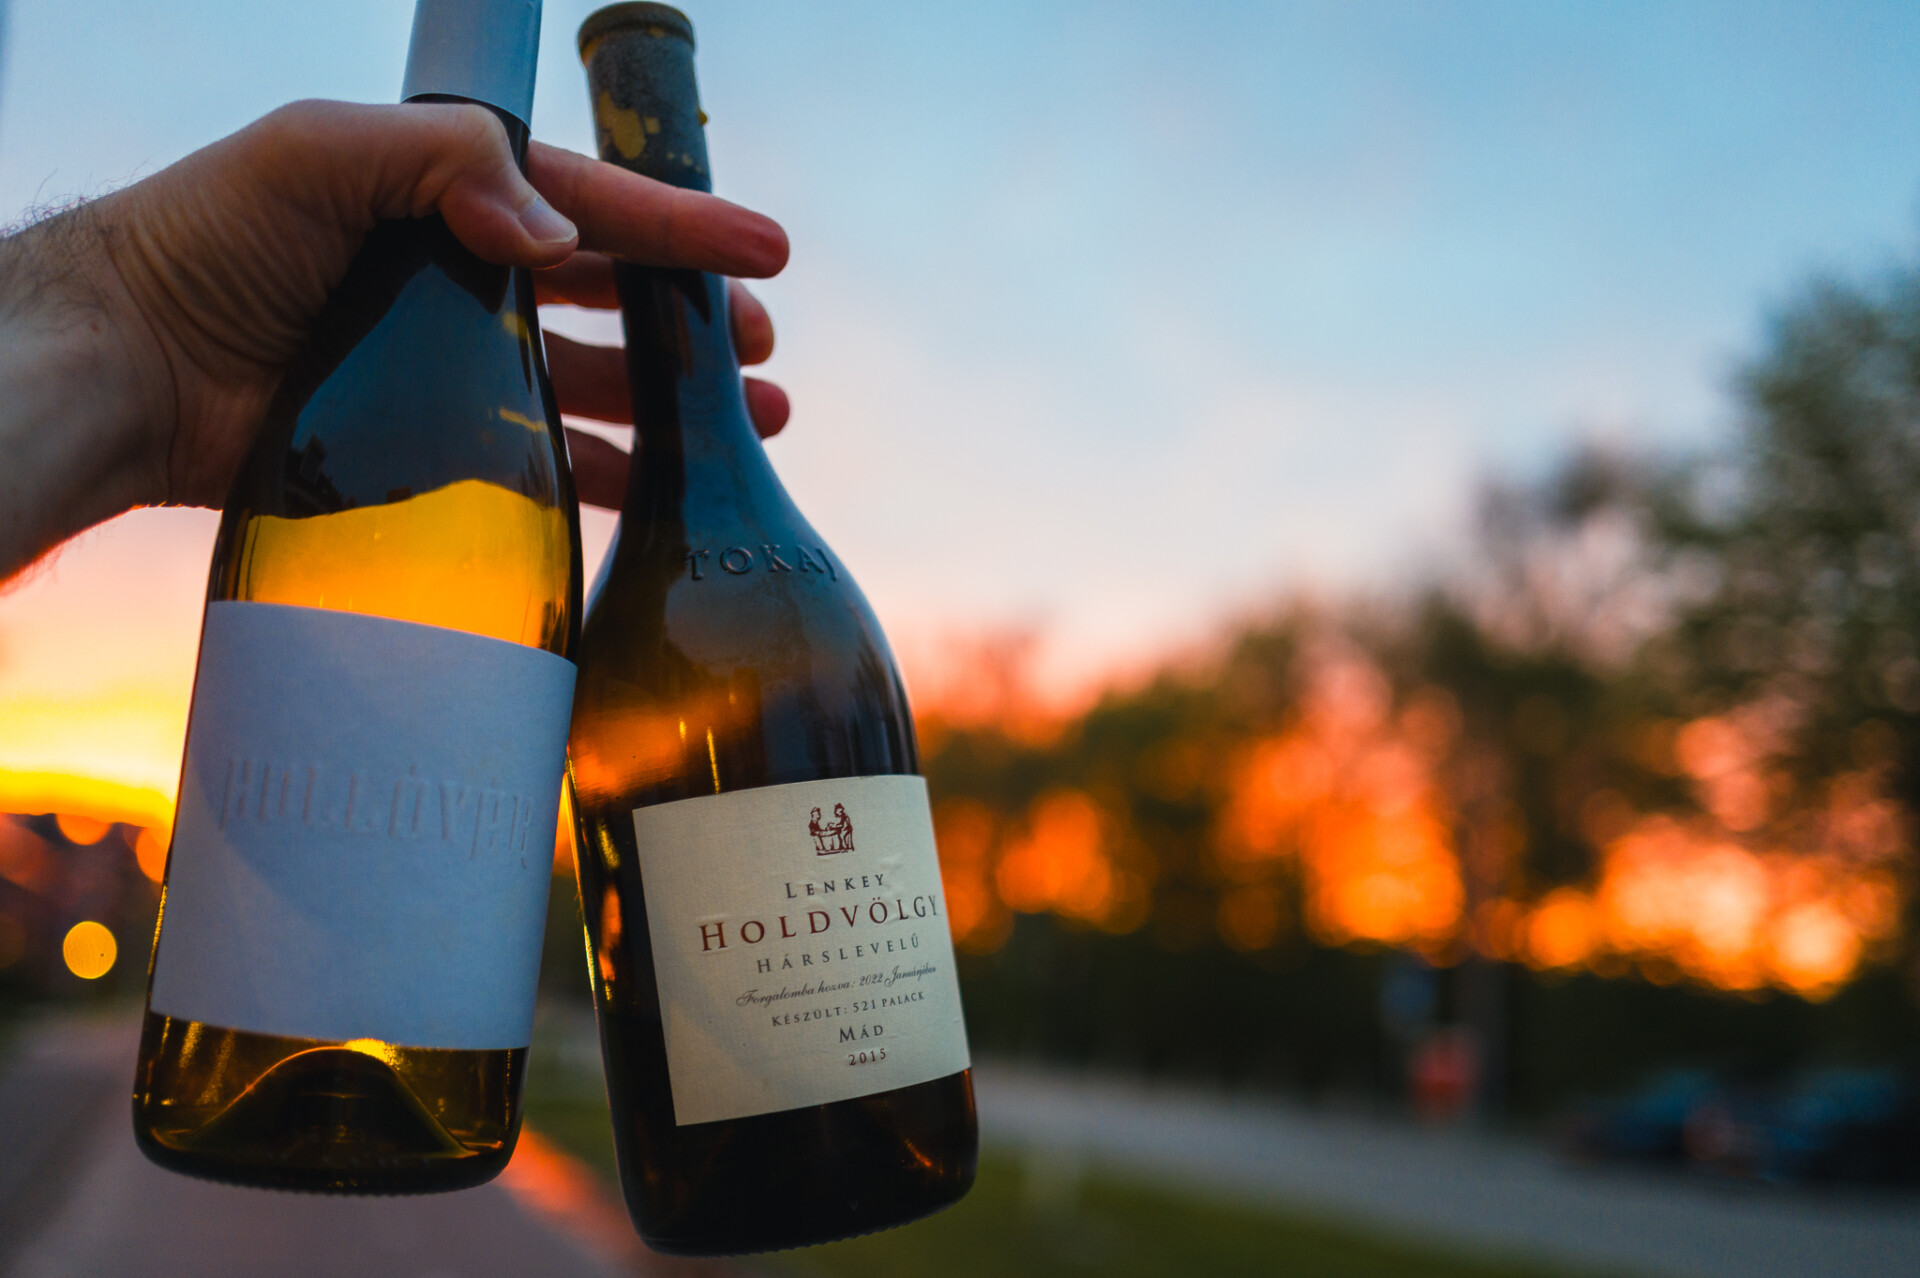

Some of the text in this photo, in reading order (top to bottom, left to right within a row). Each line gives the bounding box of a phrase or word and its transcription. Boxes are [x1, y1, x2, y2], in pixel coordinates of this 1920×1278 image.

[784, 873, 884, 899] LENKEY
[699, 896, 938, 951] HOLDVÖLGY
[736, 986, 815, 1008] Forgalomba
[858, 974, 883, 987] 2022
[852, 999, 877, 1014] 521
[882, 991, 925, 1008] PALACK
[838, 1024, 884, 1045] MÁD
[847, 1047, 887, 1067] 2015
